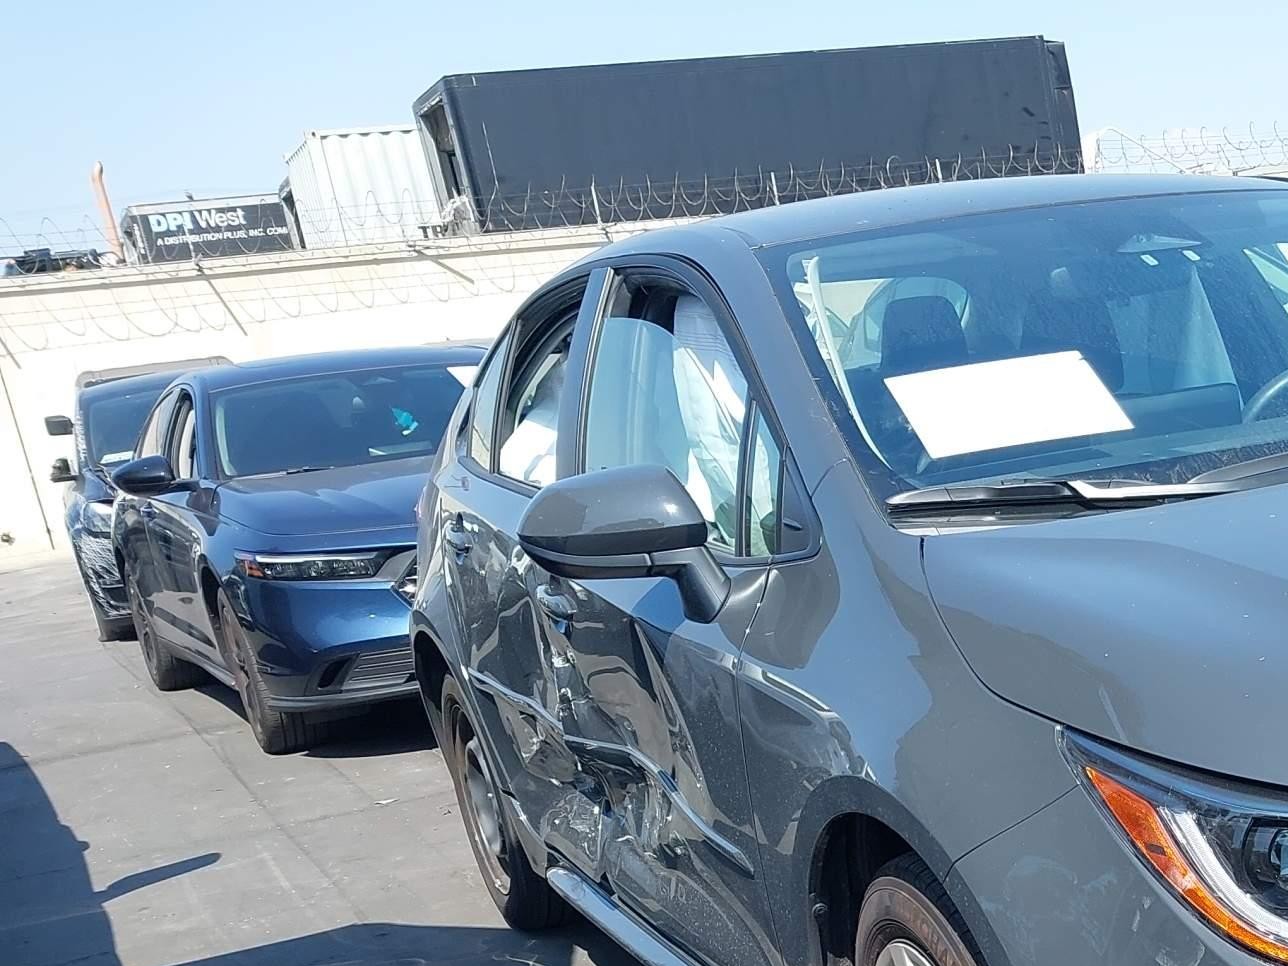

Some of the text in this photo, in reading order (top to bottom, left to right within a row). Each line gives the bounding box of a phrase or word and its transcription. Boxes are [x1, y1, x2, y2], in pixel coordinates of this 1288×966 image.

[148, 208, 247, 233] DPI West
[157, 238, 164, 247] A
[164, 233, 223, 245] DISTRIBUTION
